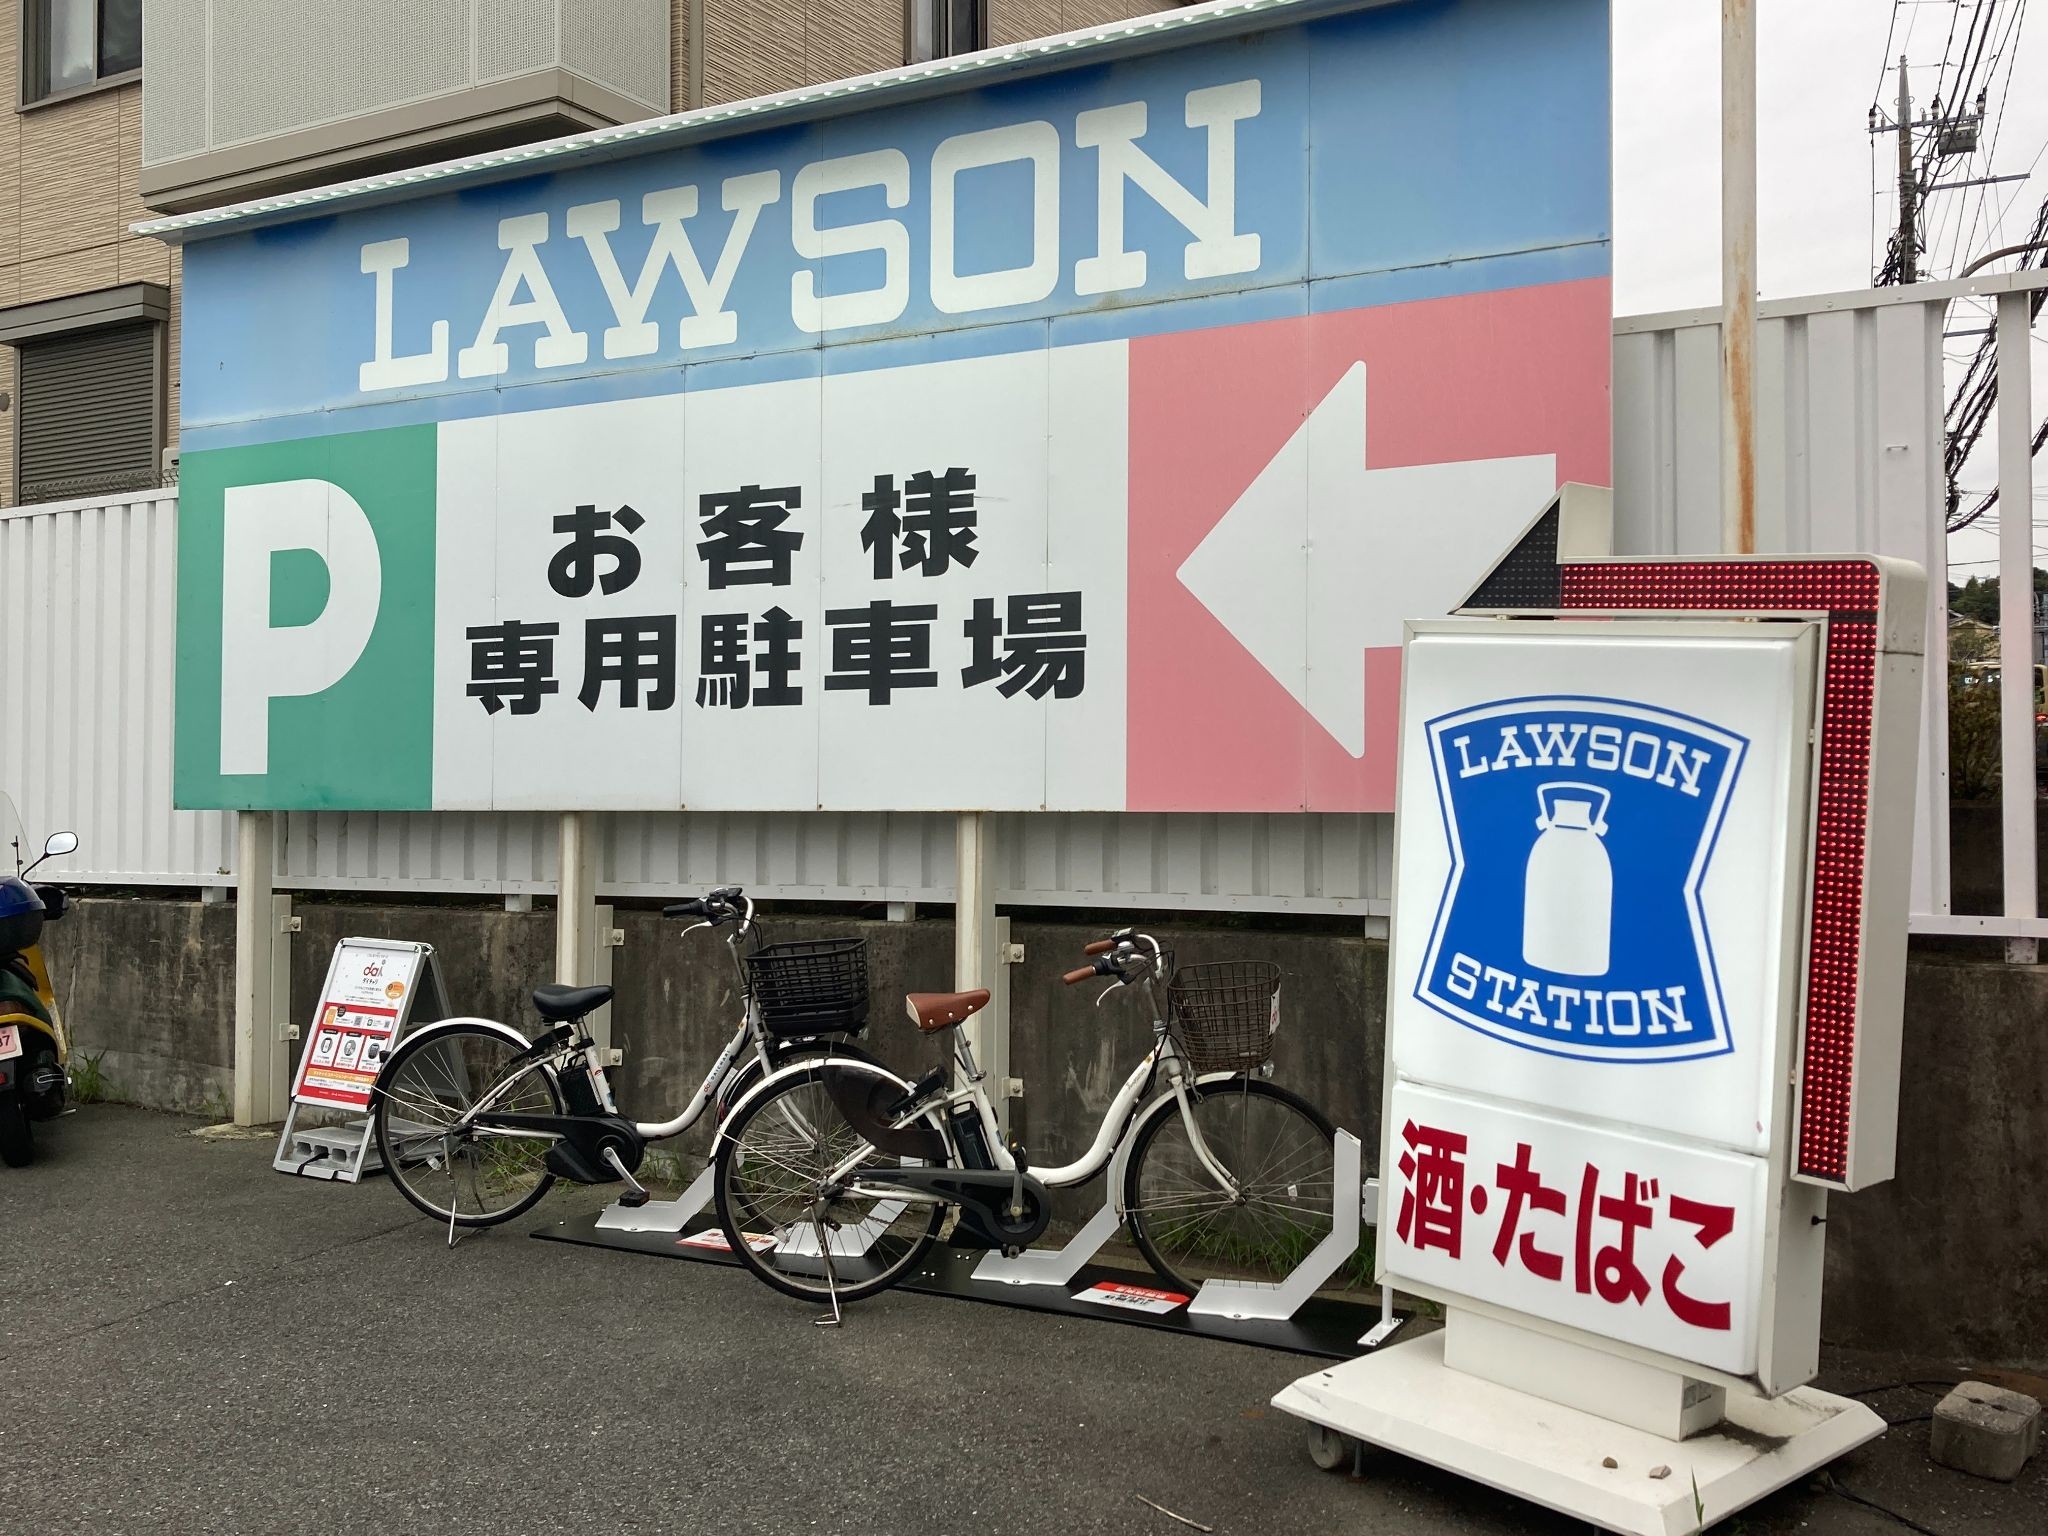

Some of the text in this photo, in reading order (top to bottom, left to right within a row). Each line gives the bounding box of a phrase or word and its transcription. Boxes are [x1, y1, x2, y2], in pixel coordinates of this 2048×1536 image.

[358, 79, 1262, 392] LAWSON
[548, 467, 980, 598] お客様
[220, 479, 382, 776] P
[465, 592, 1087, 716] 専用駐車場
[1454, 722, 1711, 797] LAWSON
[1446, 953, 1693, 1036] STATION
